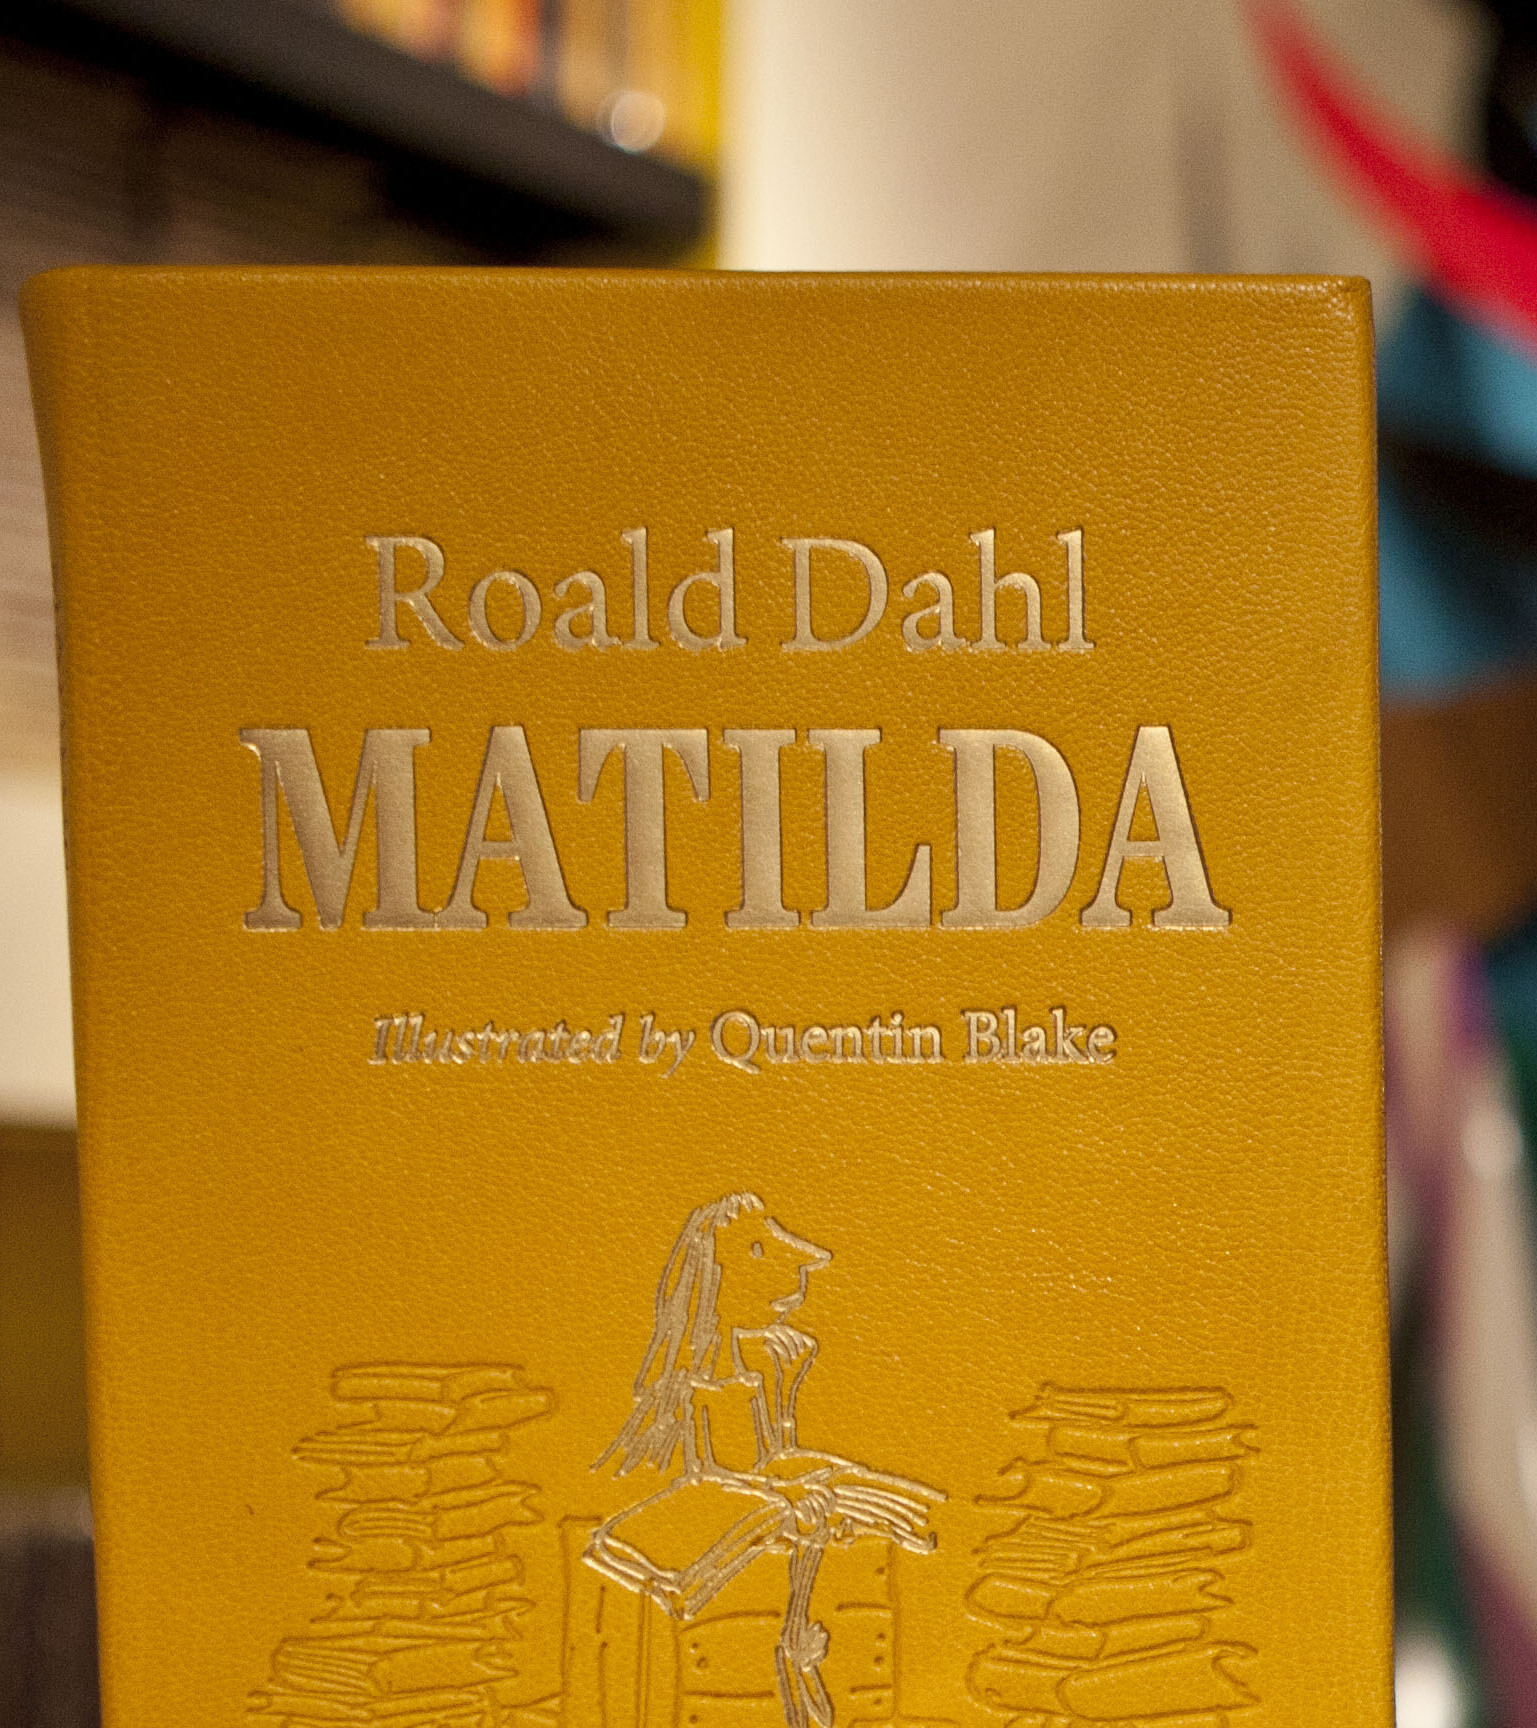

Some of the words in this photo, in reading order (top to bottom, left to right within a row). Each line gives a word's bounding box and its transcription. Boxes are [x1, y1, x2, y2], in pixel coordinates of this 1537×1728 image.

[365, 528, 746, 650] Roald
[781, 528, 1095, 653] Dahl
[239, 724, 1231, 930] MATILDA
[367, 1011, 625, 1065] Illustrated
[638, 1012, 696, 1076] by
[709, 1009, 944, 1073] Quentin
[961, 1008, 1117, 1066] Blake
